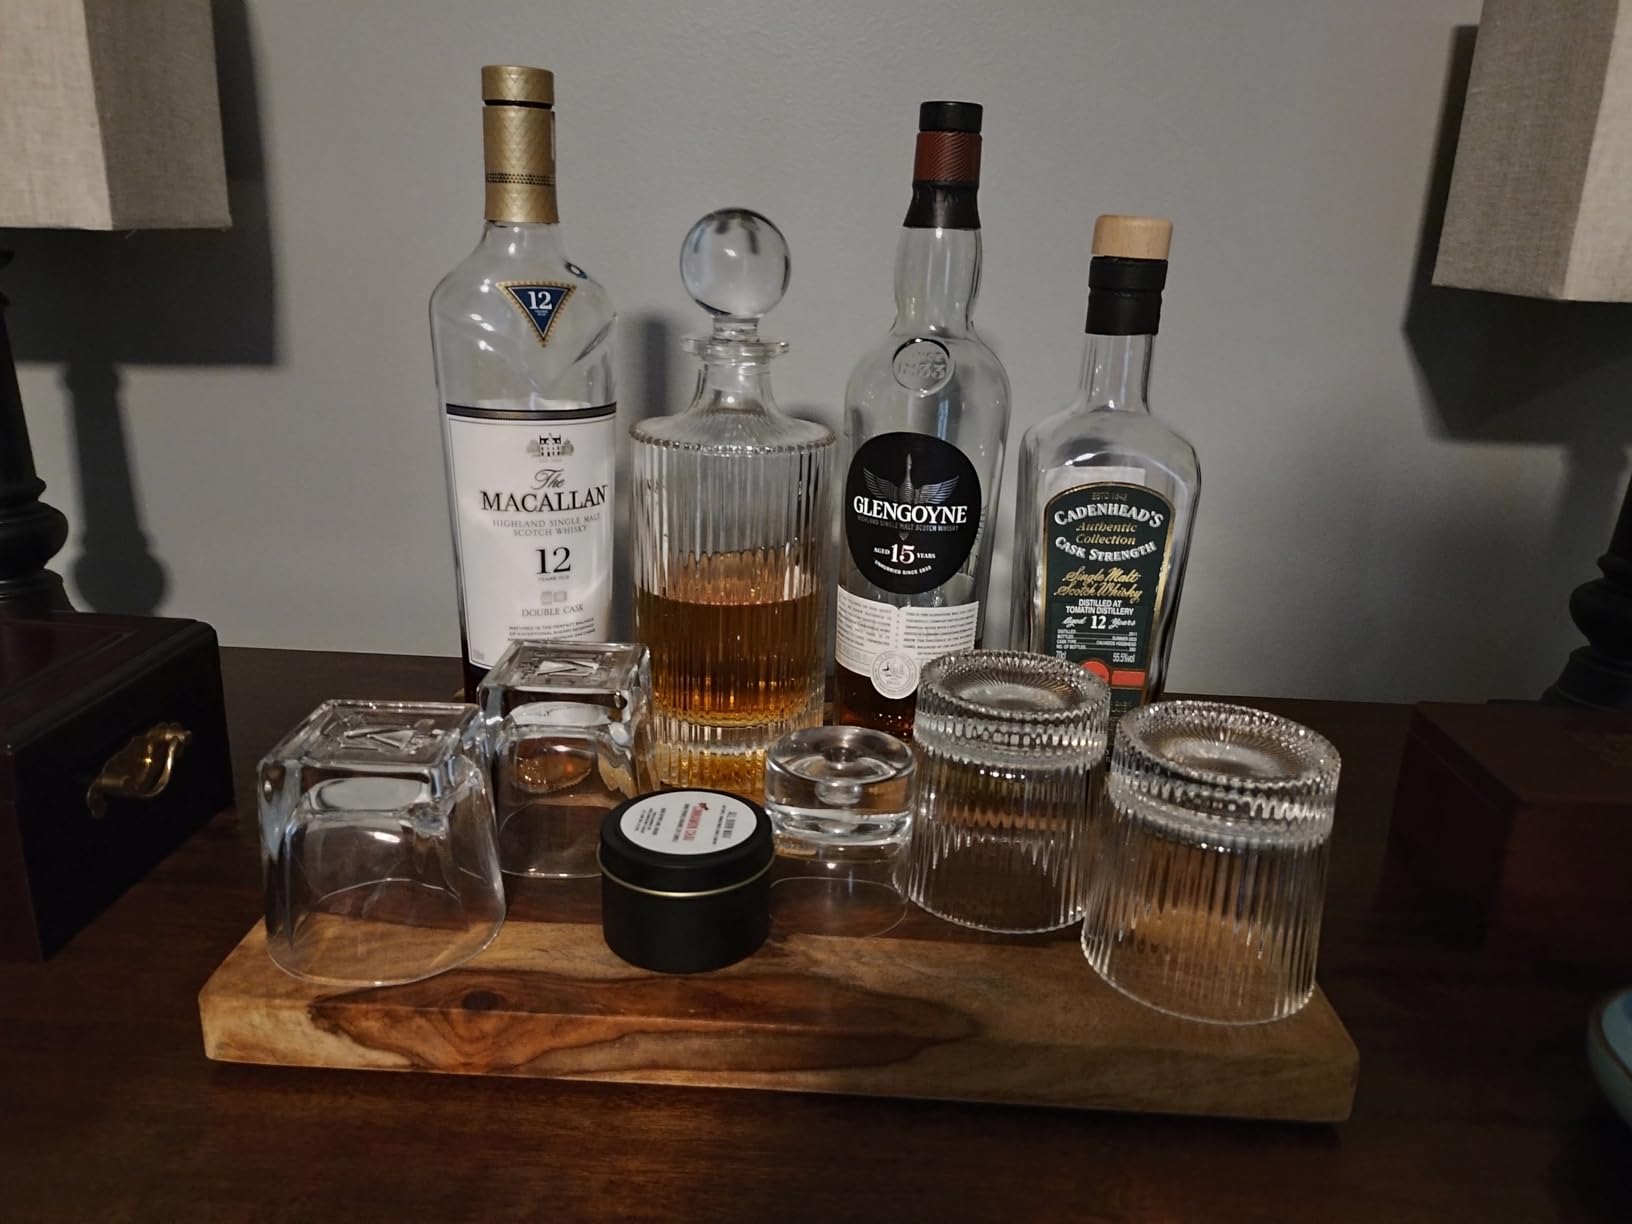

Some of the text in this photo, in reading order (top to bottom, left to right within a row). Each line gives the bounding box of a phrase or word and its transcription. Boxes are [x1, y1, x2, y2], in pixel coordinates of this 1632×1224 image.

[528, 291, 552, 310] 12
[531, 469, 565, 490] The
[480, 484, 608, 512] MACALLAN
[853, 496, 968, 524] GLENGOYNE
[1054, 503, 1164, 528] CADENHEAD'S
[492, 513, 601, 528] HIGHLAND SINGLE MALT
[1075, 522, 1138, 533] Authentic
[513, 525, 588, 537] SCOTCH WHISKY
[1075, 534, 1137, 545] Collection
[873, 547, 890, 555] AGED
[891, 543, 915, 564] 15
[1055, 536, 1157, 562] CASK STRENGTH
[536, 547, 572, 575] 12
[1062, 566, 1141, 584] Single Malt
[1053, 580, 1143, 603] Scotch Whisky
[522, 604, 584, 617] DOUBLE CASK
[1065, 606, 1135, 615] TOMATIN DISTILLERY
[1078, 599, 1112, 607] DISTILLED
[1061, 615, 1136, 630] Aged 12 Years
